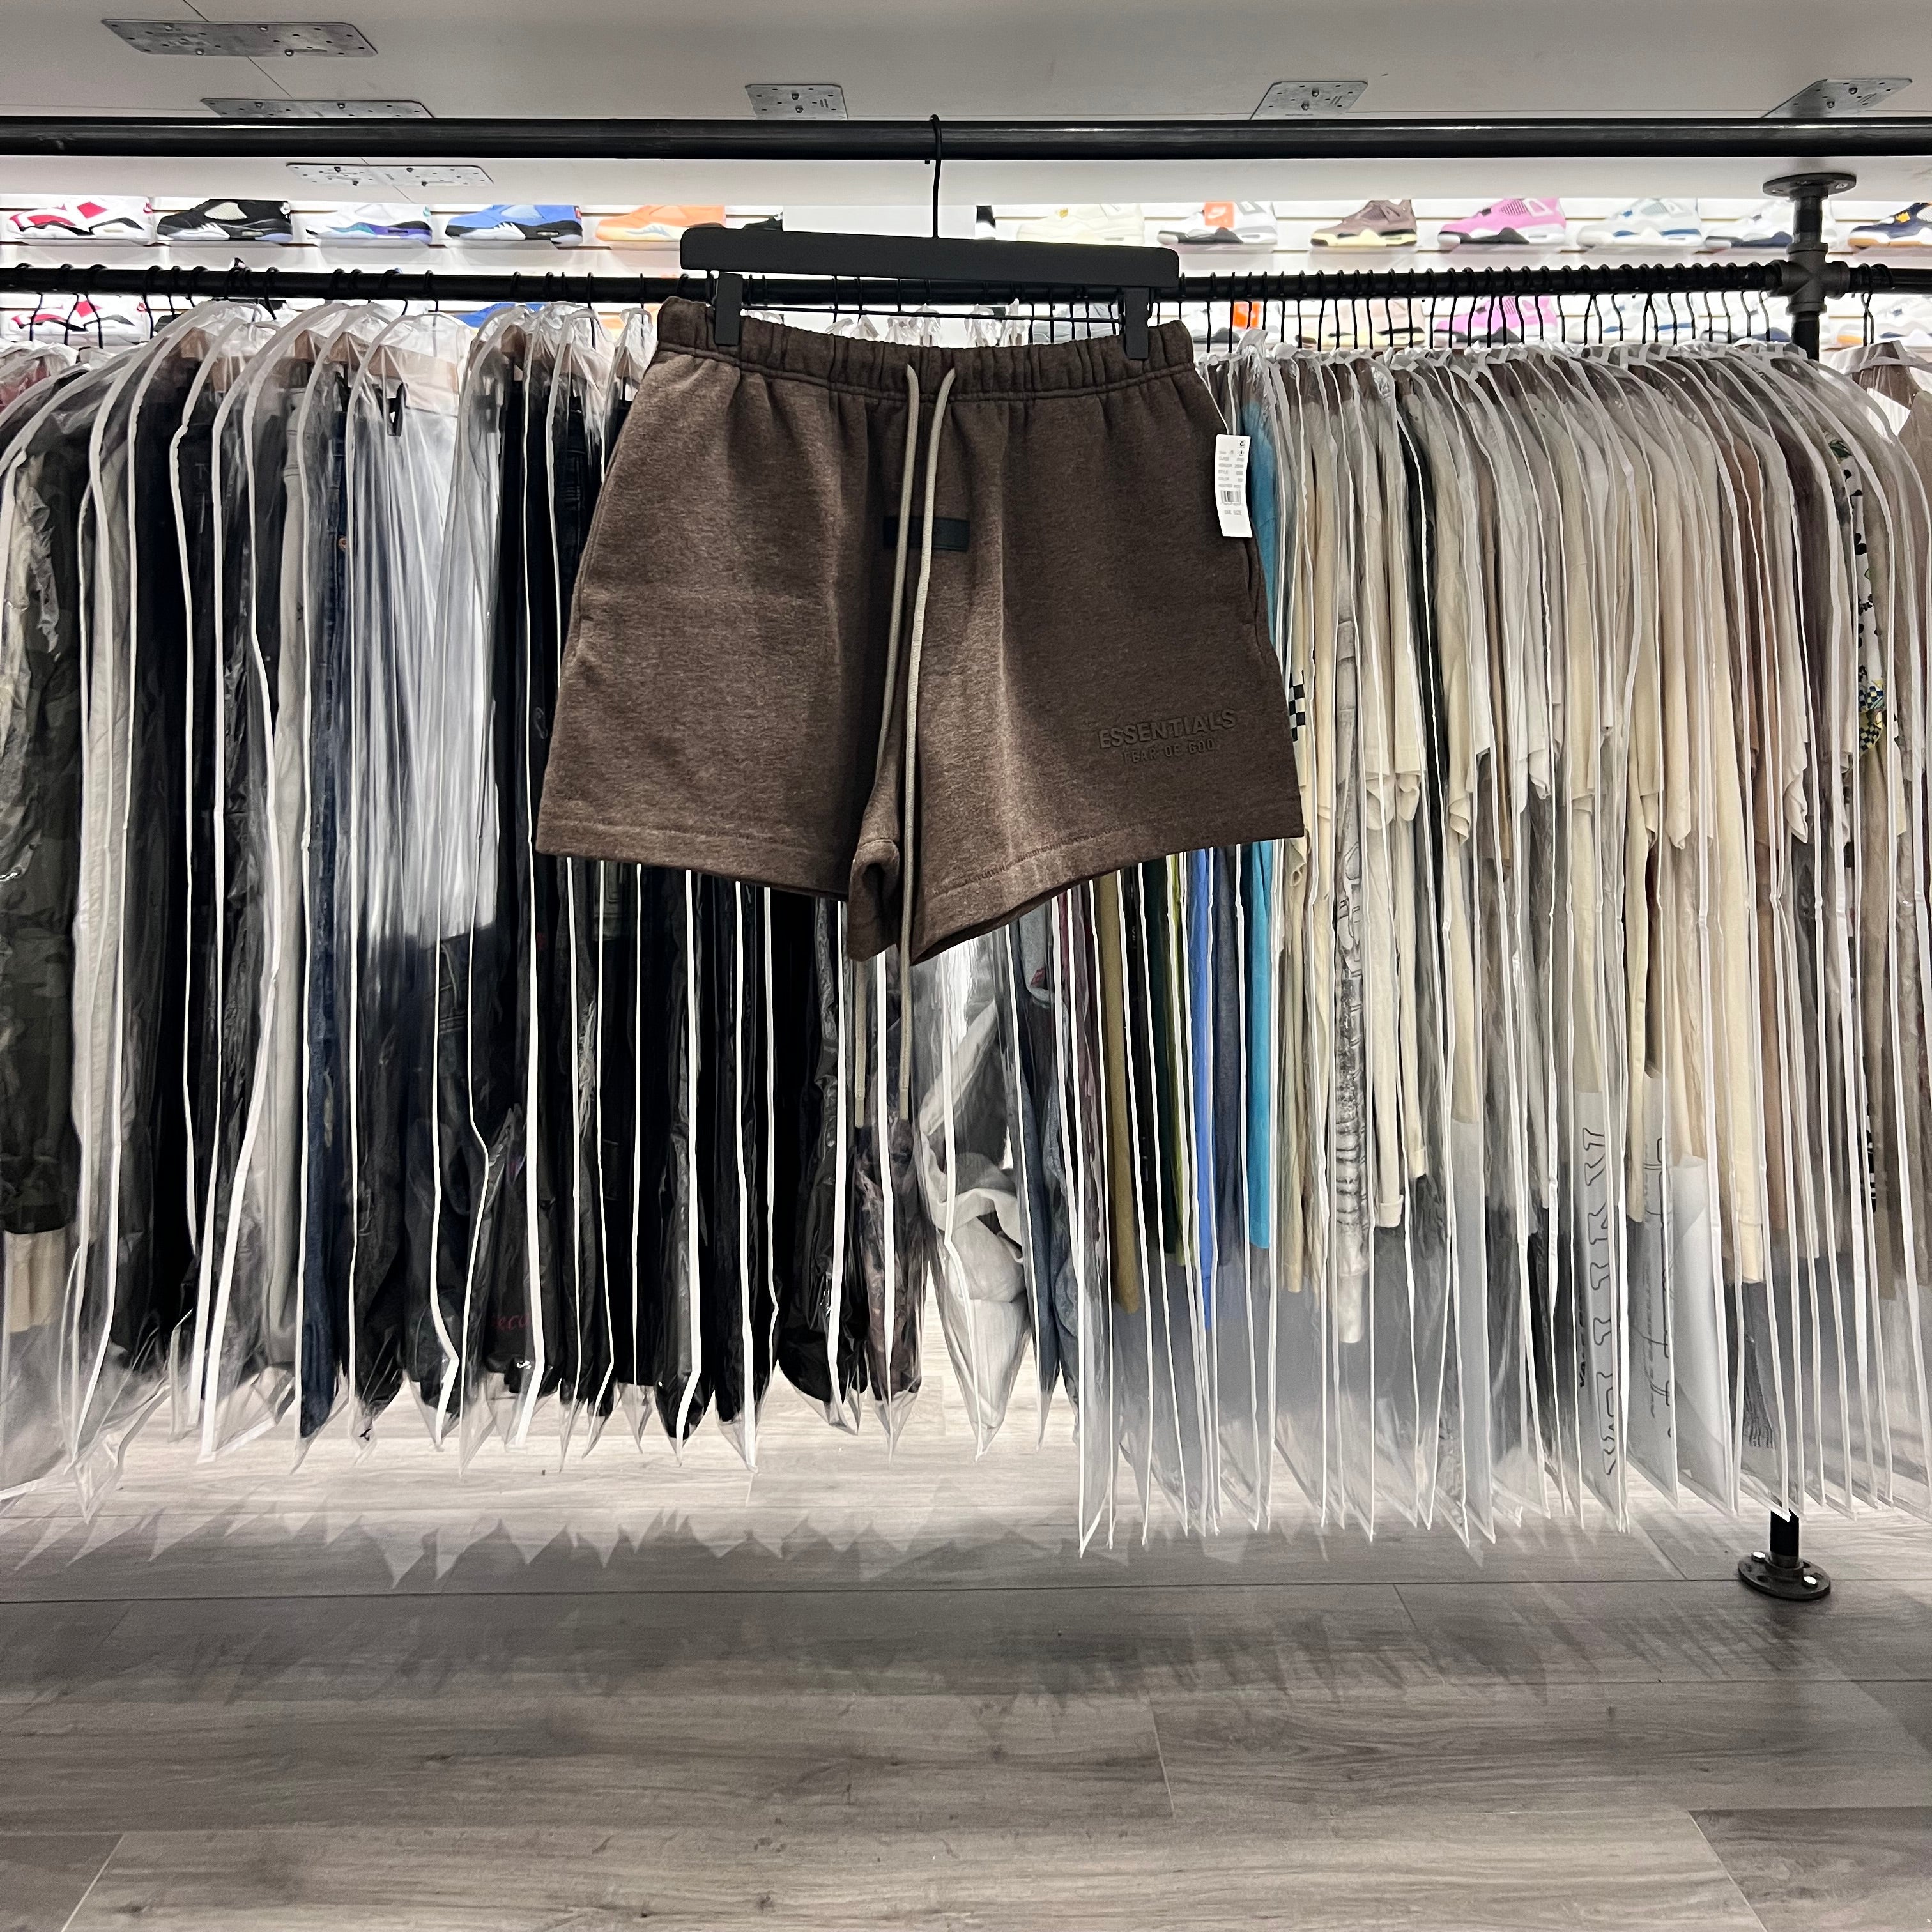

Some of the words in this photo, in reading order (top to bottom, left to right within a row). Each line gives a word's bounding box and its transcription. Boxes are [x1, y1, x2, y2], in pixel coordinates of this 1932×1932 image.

[1099, 708, 1237, 749] ESSENTIALS
[1123, 747, 1156, 763] FEAR
[1188, 738, 1215, 754] GOD
